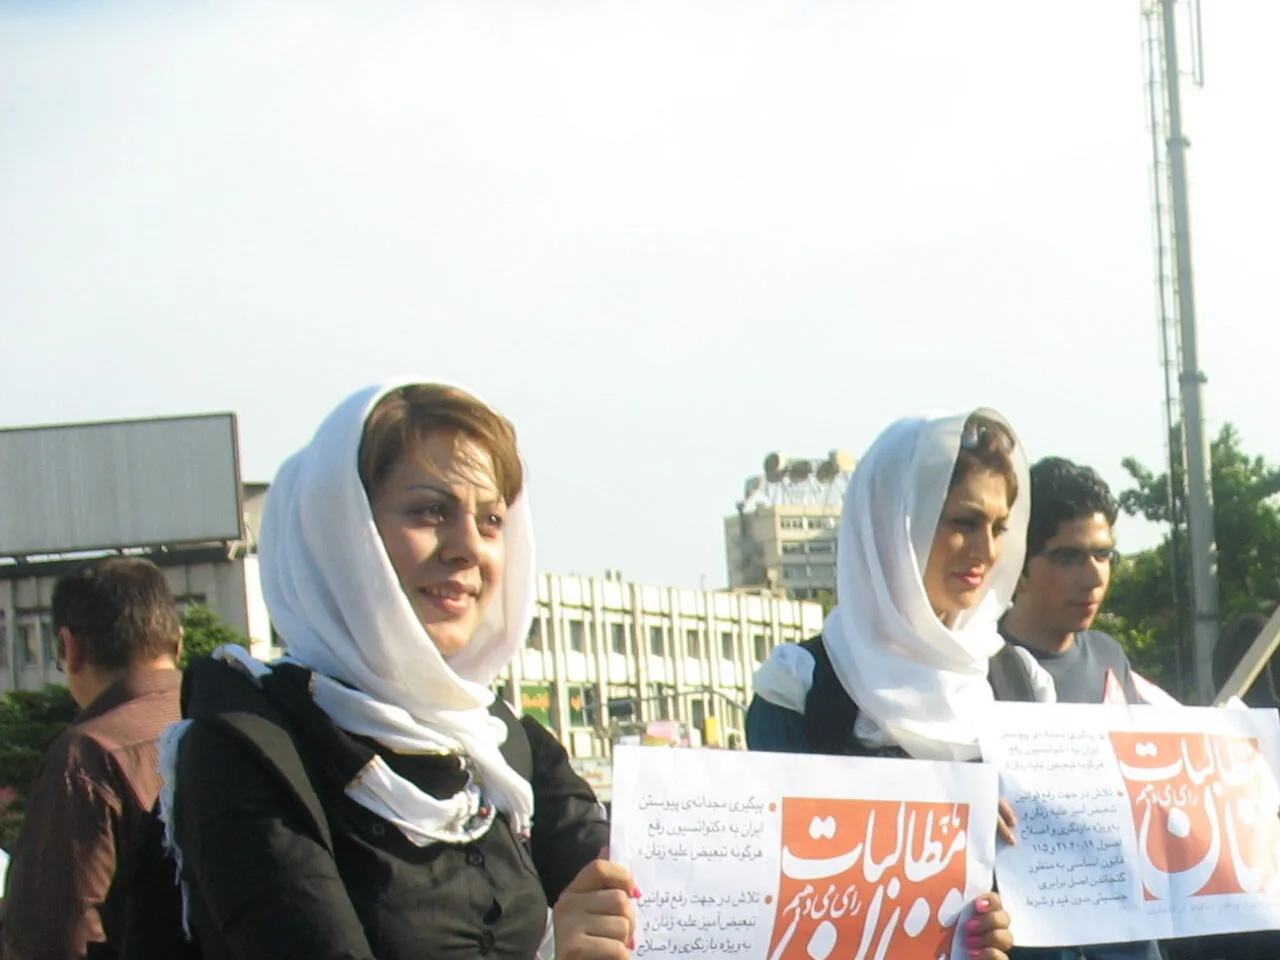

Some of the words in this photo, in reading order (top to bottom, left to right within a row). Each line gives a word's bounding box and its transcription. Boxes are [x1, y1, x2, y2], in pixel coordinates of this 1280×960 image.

[638, 794, 680, 812] پیوستن
[729, 795, 765, 814] پیگیری
[647, 818, 666, 838] رفع
[740, 821, 764, 837] ایران
[668, 843, 688, 862] علیه
[690, 848, 729, 862] تبعیض
[781, 799, 967, 899] مطالبات
[670, 891, 689, 909] رفع
[690, 893, 716, 907] جهت
[717, 894, 731, 908] در
[731, 891, 760, 908] تلاش
[651, 914, 675, 932] زنان
[677, 913, 698, 931] علیه
[636, 938, 671, 957] اصلاح
